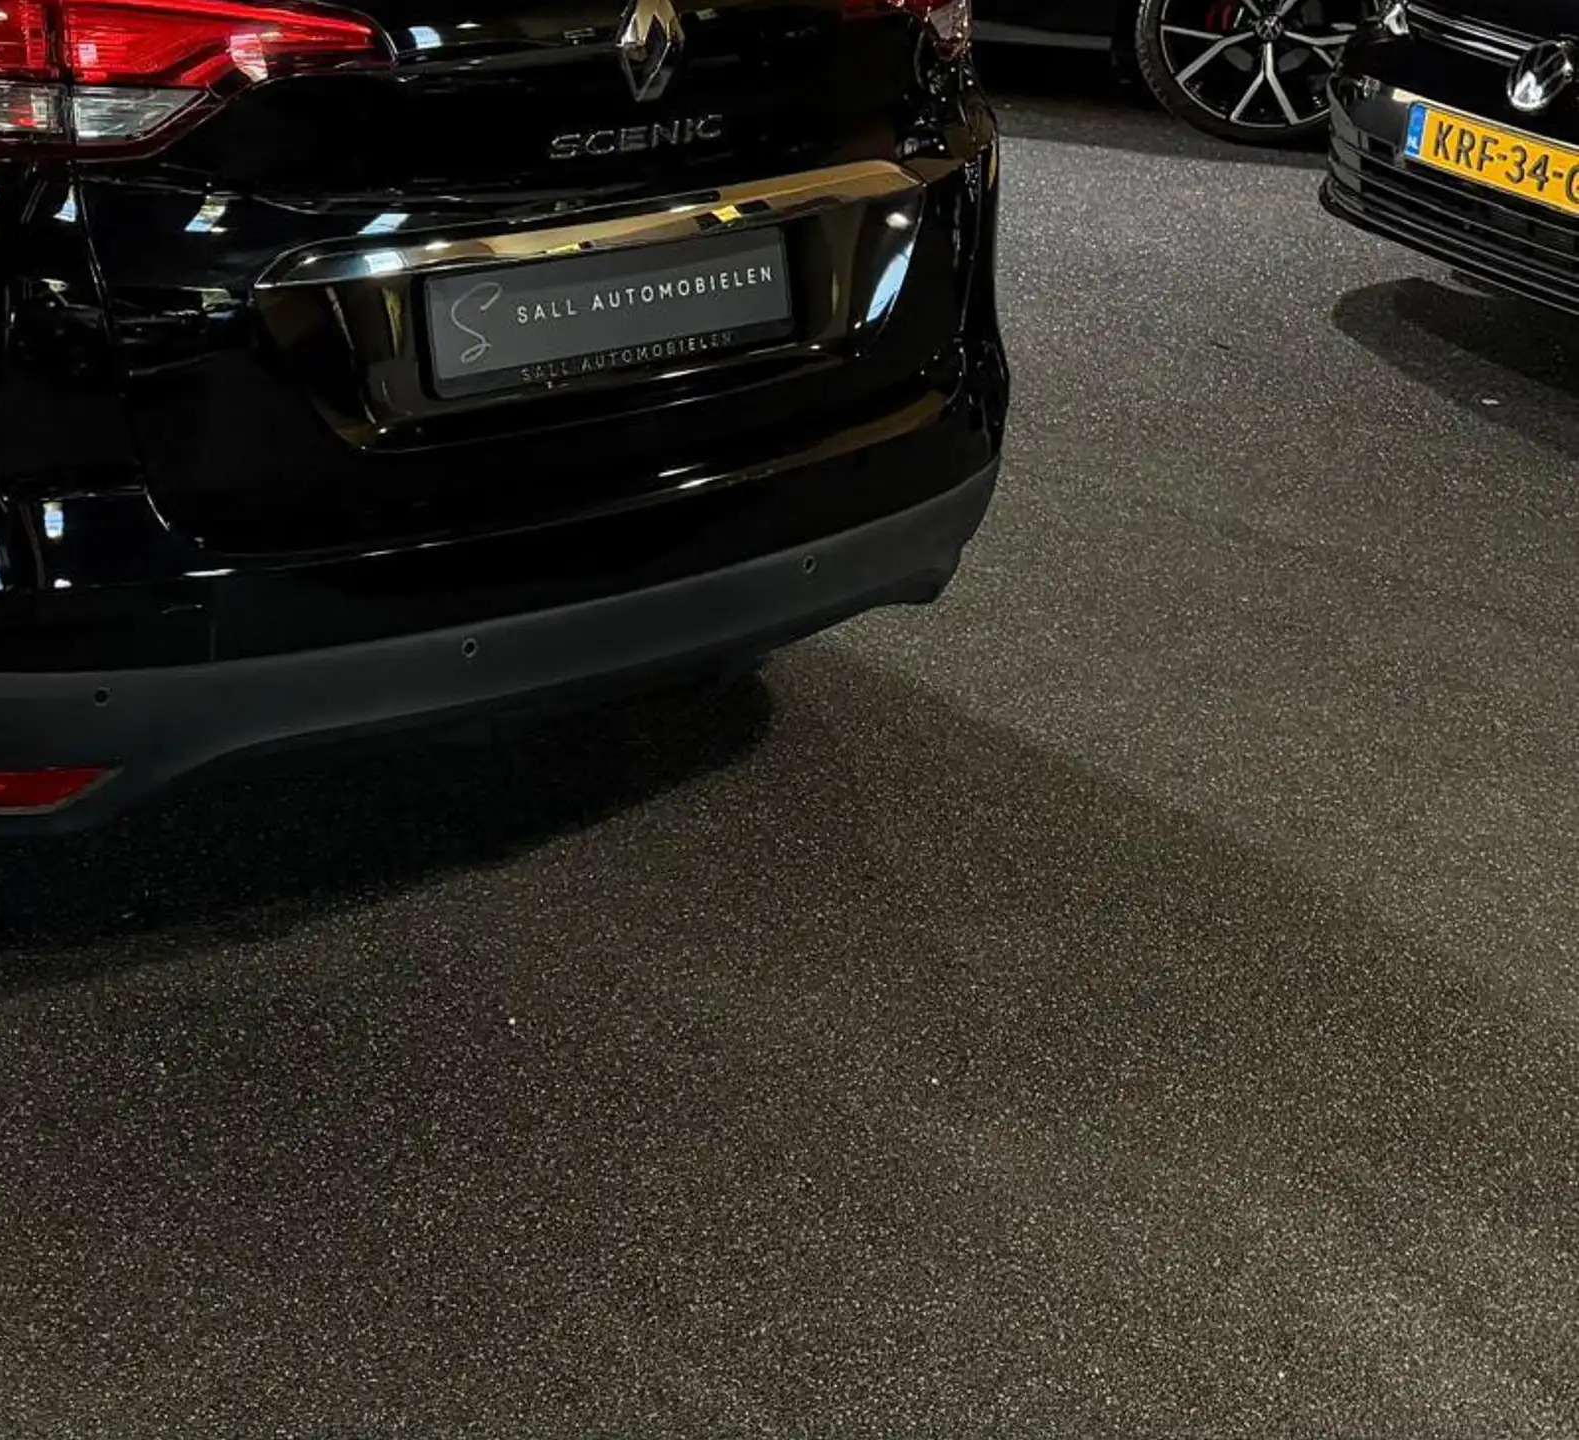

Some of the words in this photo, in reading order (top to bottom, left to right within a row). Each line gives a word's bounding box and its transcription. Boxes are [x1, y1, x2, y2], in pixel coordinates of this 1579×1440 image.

[550, 114, 723, 160] SCENIC
[517, 299, 579, 325] SALL
[591, 266, 774, 313] AUTOMOBIELEN
[521, 362, 570, 382] SALL
[581, 331, 734, 371] AUTOMOBIELEN
